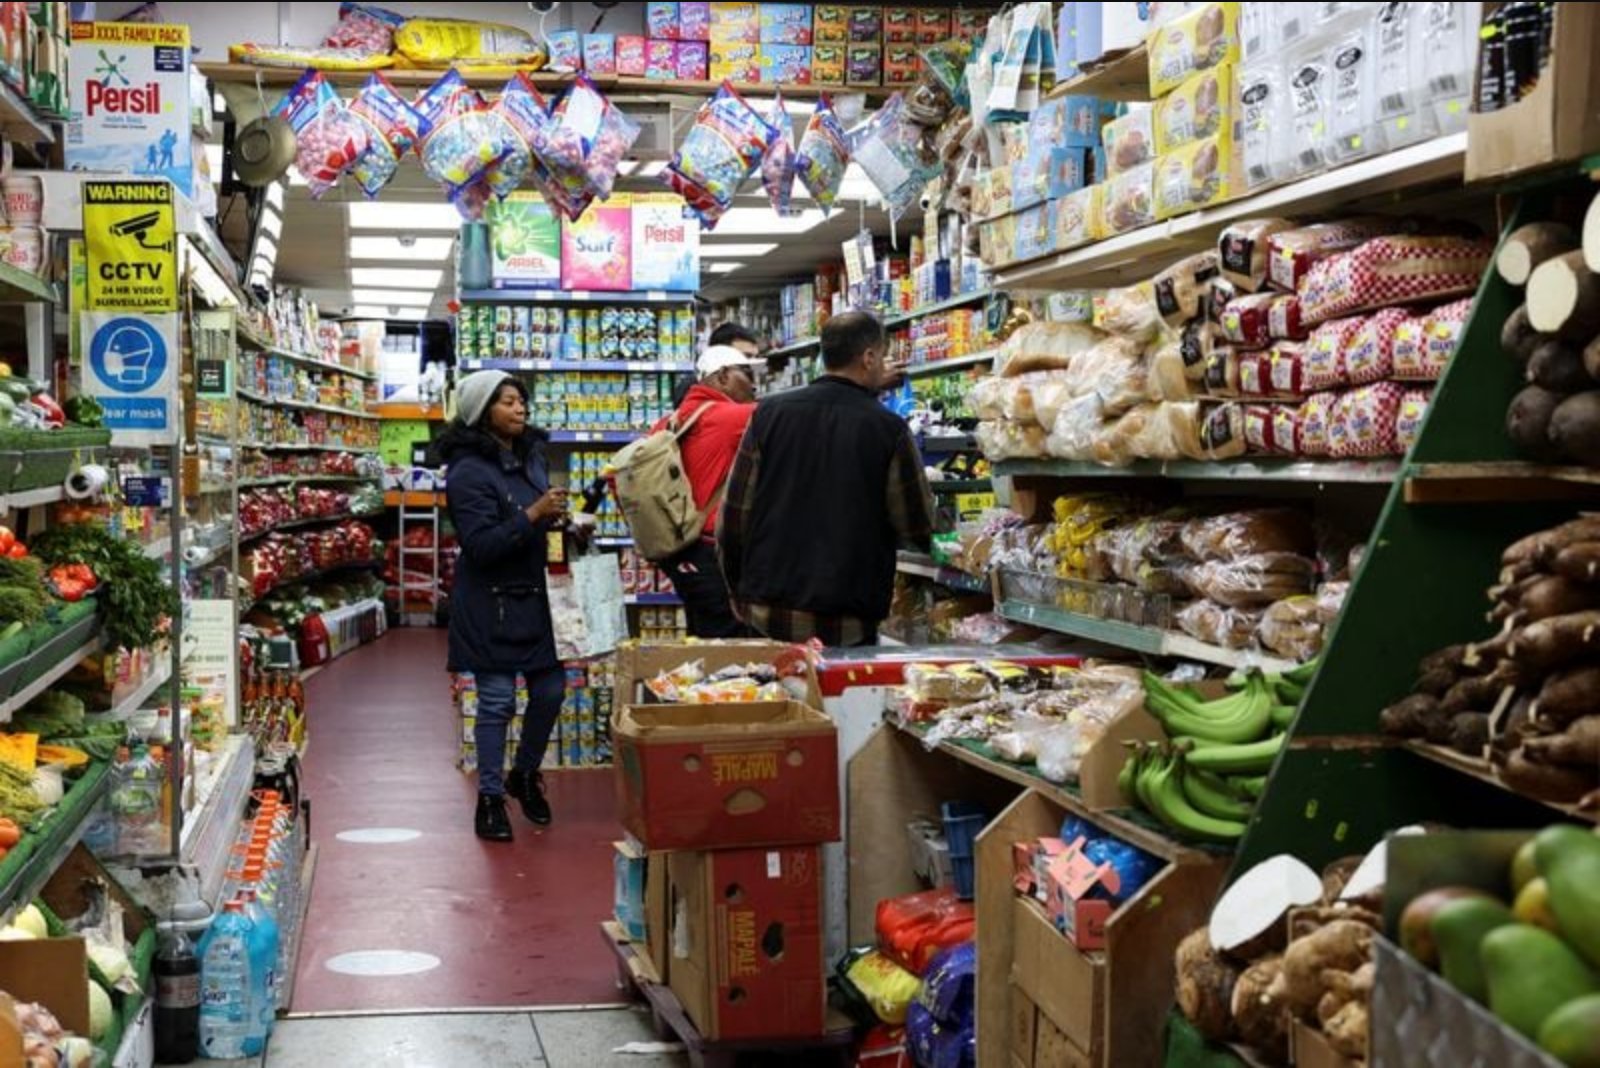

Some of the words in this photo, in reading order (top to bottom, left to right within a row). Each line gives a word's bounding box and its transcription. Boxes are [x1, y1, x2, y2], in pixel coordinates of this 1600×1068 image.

[97, 26, 121, 40] XXXL
[123, 27, 156, 42] FAMILY
[159, 29, 183, 43] PACK
[86, 80, 160, 117] Persil
[87, 184, 168, 200] WARNING
[645, 224, 686, 245] Persil
[576, 236, 615, 253] Surf
[99, 261, 163, 281] CCTV
[507, 257, 546, 269] ARIEL
[101, 285, 114, 294] 24
[116, 286, 130, 294] HR
[132, 285, 164, 294] VIDEO
[95, 298, 171, 307] SURVEILLANCE
[130, 407, 164, 419] mask
